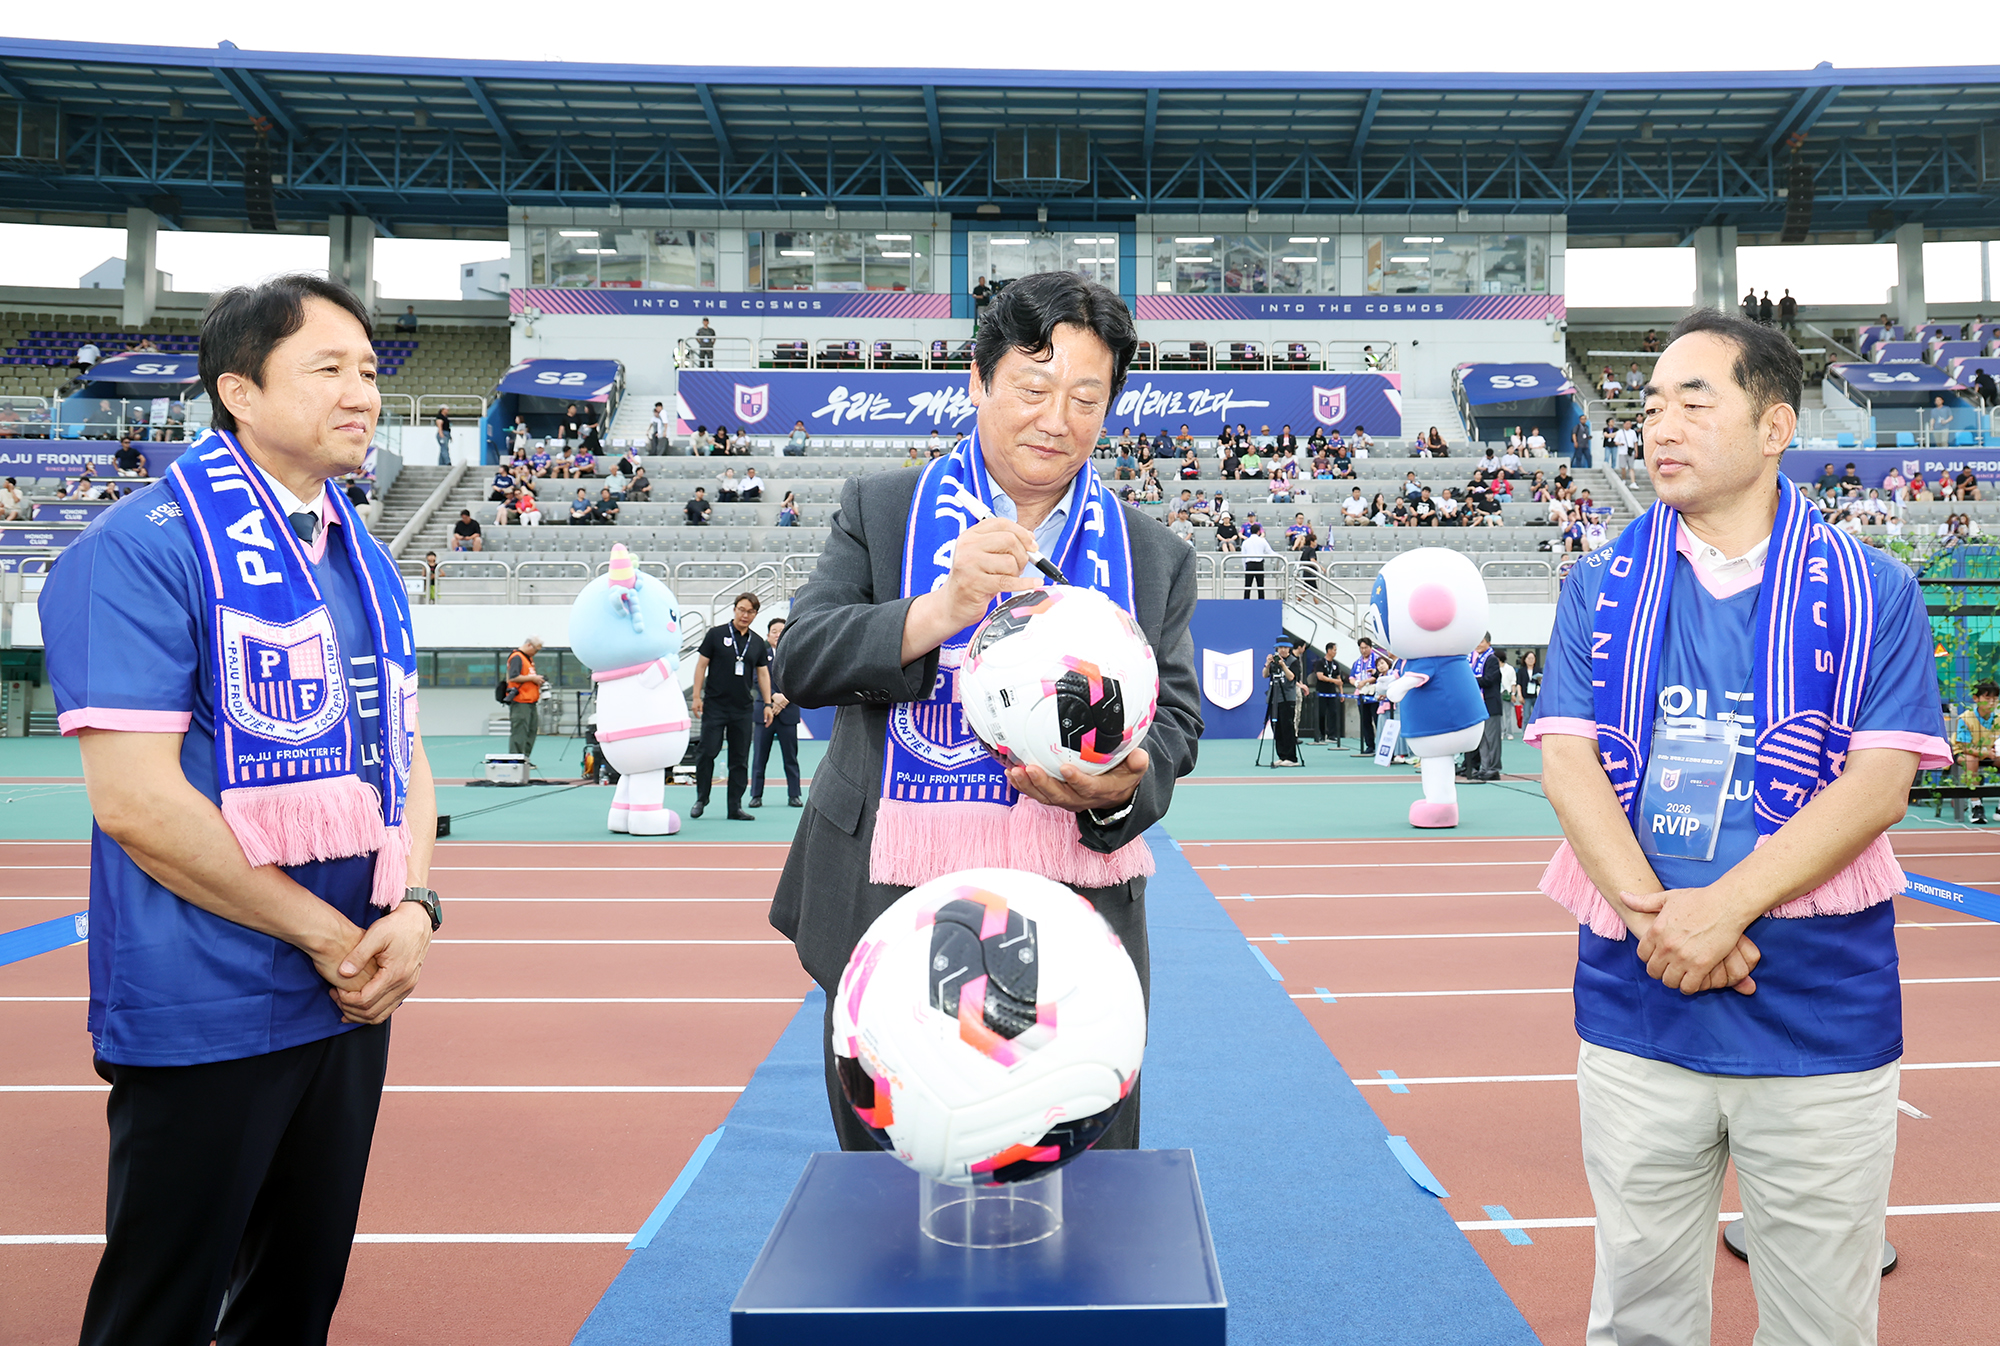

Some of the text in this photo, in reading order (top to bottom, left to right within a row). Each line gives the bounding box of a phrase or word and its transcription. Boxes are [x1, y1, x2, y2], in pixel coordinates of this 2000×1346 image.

[633, 299, 822, 310] INTO THE COSMOS
[1261, 304, 1444, 313] INTO THE COSMOS
[130, 363, 180, 375] S1
[534, 371, 588, 386] S2
[1489, 374, 1539, 389] S3
[743, 394, 751, 404] P
[811, 382, 1270, 429] 우리는 개척 미래로 간다
[1322, 396, 1329, 406] P
[753, 404, 760, 414] F
[1331, 406, 1338, 416] F
[0, 453, 119, 465] AJU FRONTIER
[1924, 461, 1964, 472] PAJU
[1591, 555, 1634, 688] INTO
[248, 620, 314, 640] SINCE 2012
[258, 650, 281, 678] P
[1216, 665, 1226, 679] P
[228, 647, 276, 732] PAJU FRONTIER
[314, 644, 342, 729] FOOTBALL CLUB
[1230, 681, 1240, 694] F
[298, 682, 318, 710] F
[239, 746, 343, 764] PAJU FRONTIER FC
[896, 771, 1003, 784] PAJU FRONTIER FC
[1665, 802, 1692, 814] 2026
[1651, 813, 1701, 837] RVIP
[1913, 882, 1952, 900] FRONTIER
[1953, 893, 1964, 904] FC
